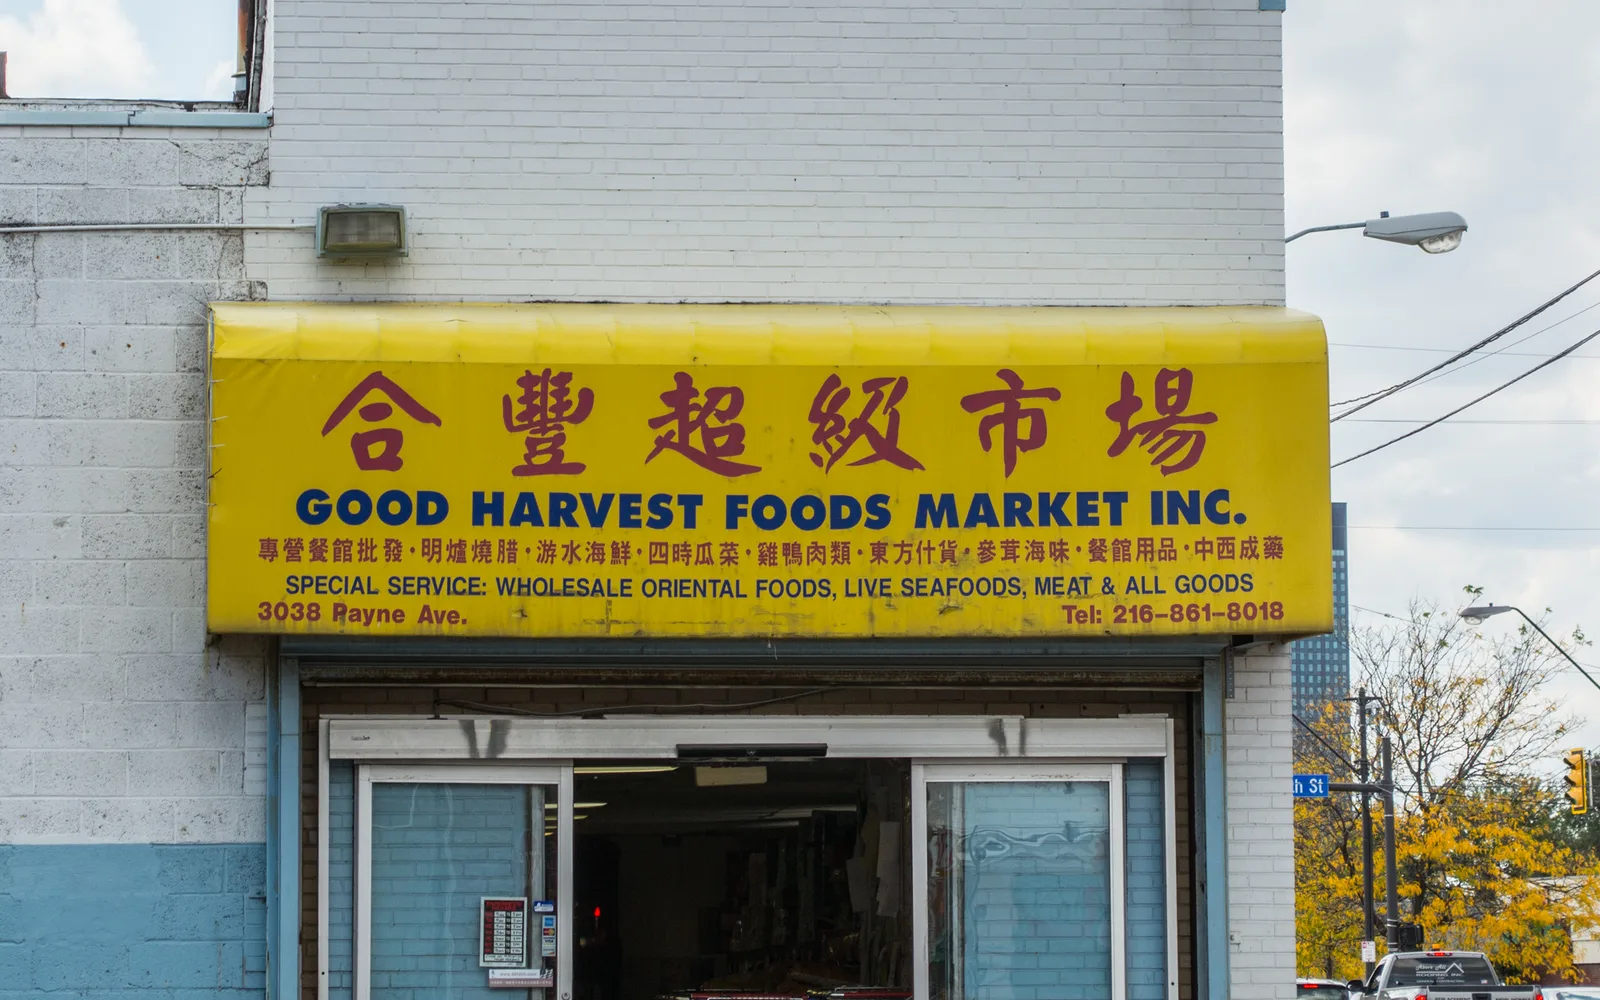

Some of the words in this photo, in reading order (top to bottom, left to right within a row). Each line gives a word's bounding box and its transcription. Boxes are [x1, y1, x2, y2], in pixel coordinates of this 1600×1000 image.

[296, 489, 449, 526] GOOD
[472, 492, 703, 529] HARVEST
[726, 494, 891, 531] FOODS
[915, 491, 1128, 528] MARKET
[1151, 489, 1247, 525] INC.
[285, 575, 379, 595] SPECIAL
[387, 576, 487, 596] SERVICE:
[496, 577, 633, 598] WHOLESALE
[642, 579, 748, 598] ORIENTAL
[756, 578, 836, 601] FOODS,
[844, 578, 892, 598] LIVE
[900, 577, 1027, 600] SEAFOODS,
[1034, 577, 1092, 596] MEAT
[1101, 577, 1116, 595] &
[1125, 576, 1165, 595] ALL
[1174, 574, 1254, 594] GOODS
[257, 602, 321, 622] 3038
[332, 603, 405, 627] Payne
[418, 604, 468, 626] Ave.
[1062, 604, 1103, 625] Tel:
[1113, 602, 1284, 625] 216-861-8018
[1293, 778, 1304, 793] h
[1309, 778, 1323, 793] St
